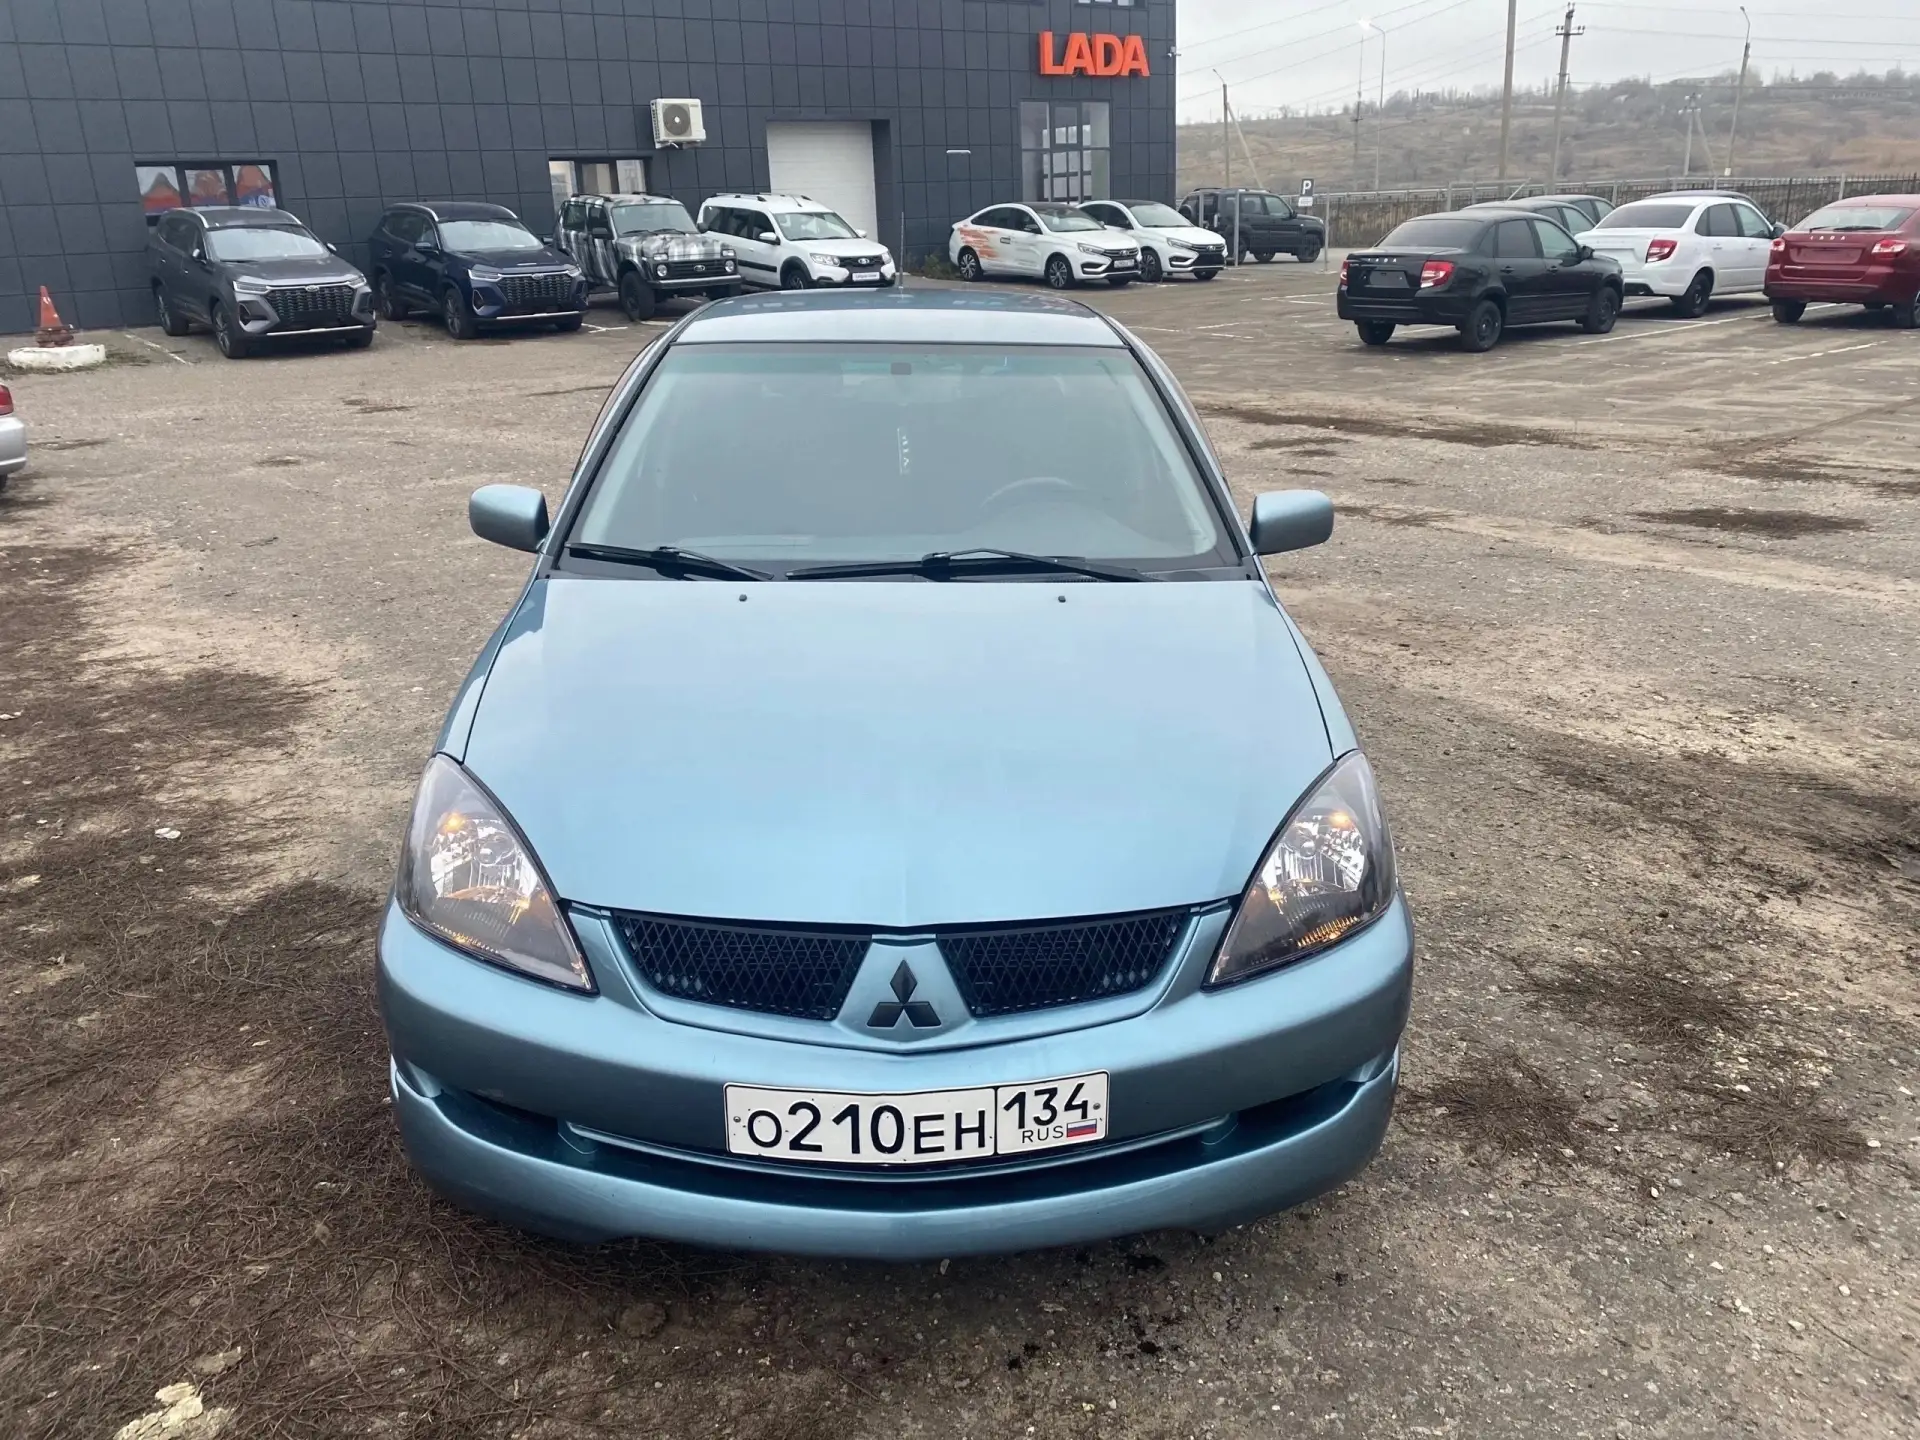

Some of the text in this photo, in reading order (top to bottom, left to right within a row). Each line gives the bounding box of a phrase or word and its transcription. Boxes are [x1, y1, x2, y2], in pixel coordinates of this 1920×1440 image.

[1040, 31, 1151, 76] LADA
[1302, 180, 1312, 195] P
[1003, 1082, 1089, 1130] 134
[1021, 1125, 1064, 1144] RUS
